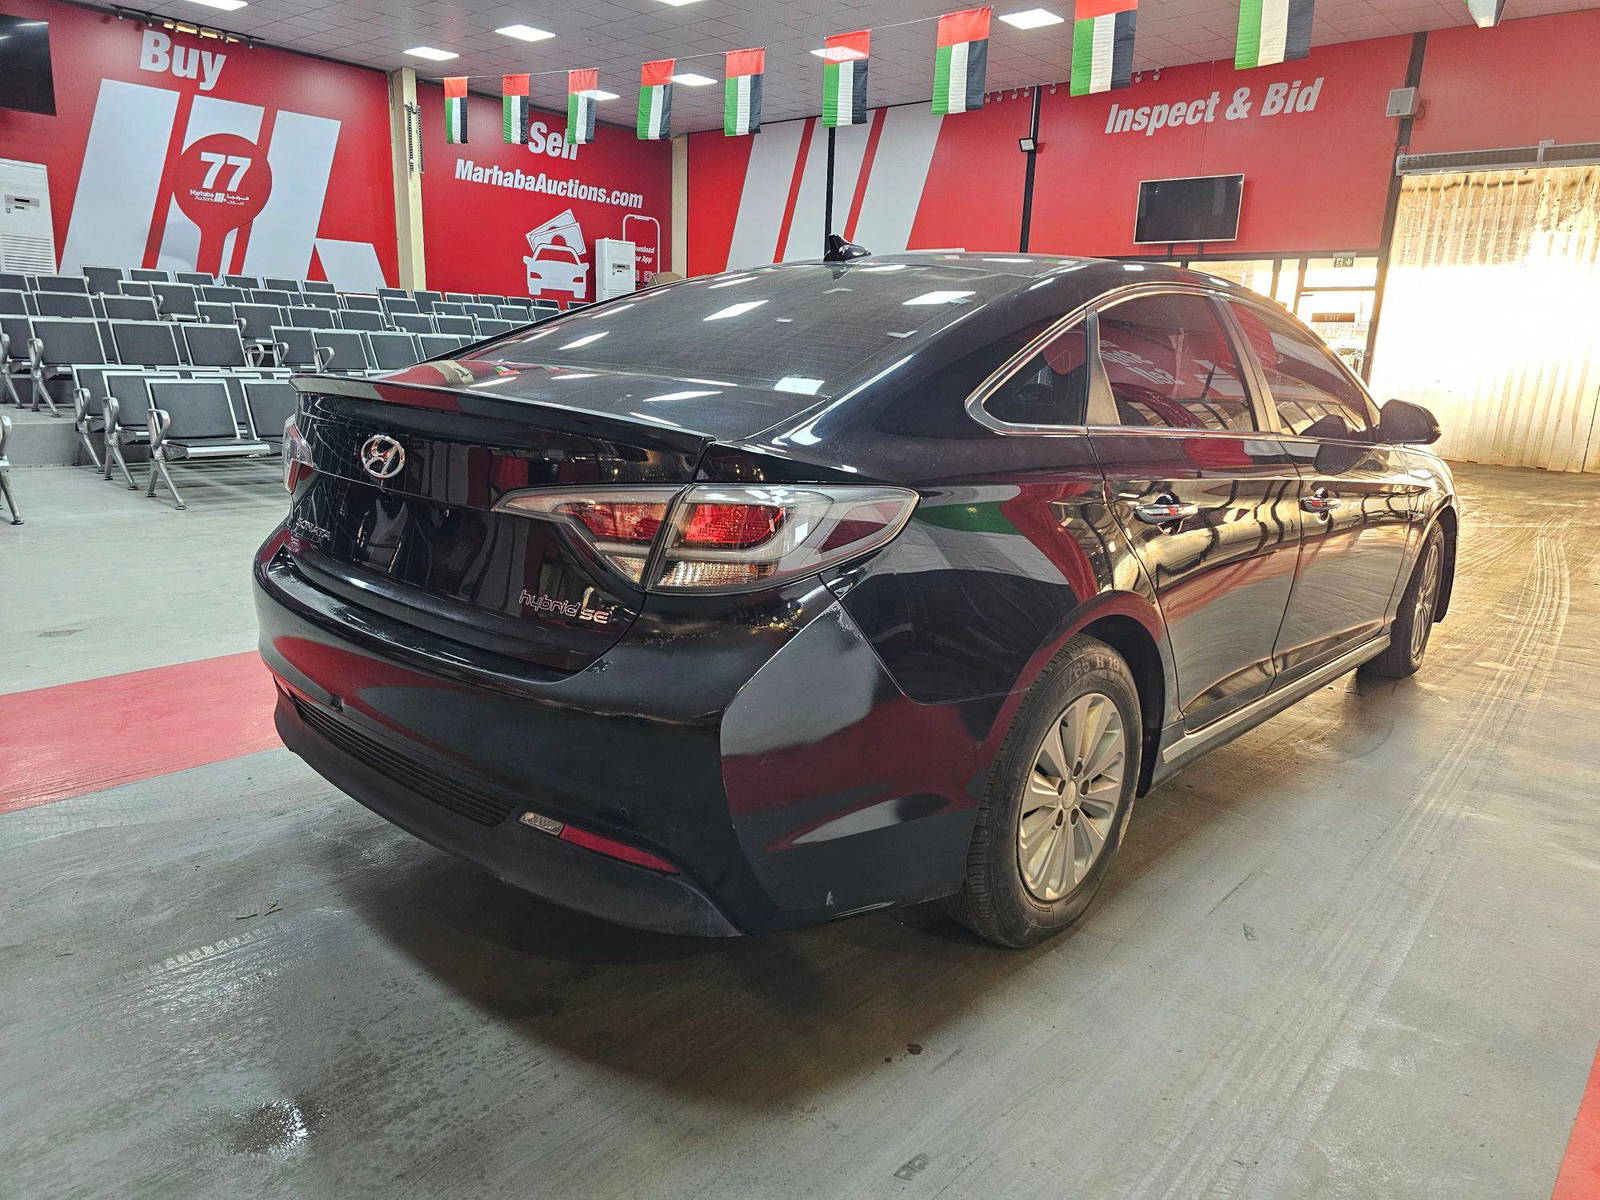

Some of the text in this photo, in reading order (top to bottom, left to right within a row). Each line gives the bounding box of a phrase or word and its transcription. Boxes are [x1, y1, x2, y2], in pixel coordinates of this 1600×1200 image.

[140, 30, 226, 91] Buy
[1105, 77, 1324, 136] Inspect & Bid
[528, 121, 578, 160] Sell
[201, 152, 252, 192] 77
[454, 159, 643, 208] MarhabaAuctions.com
[519, 589, 610, 624] hybrid SE
